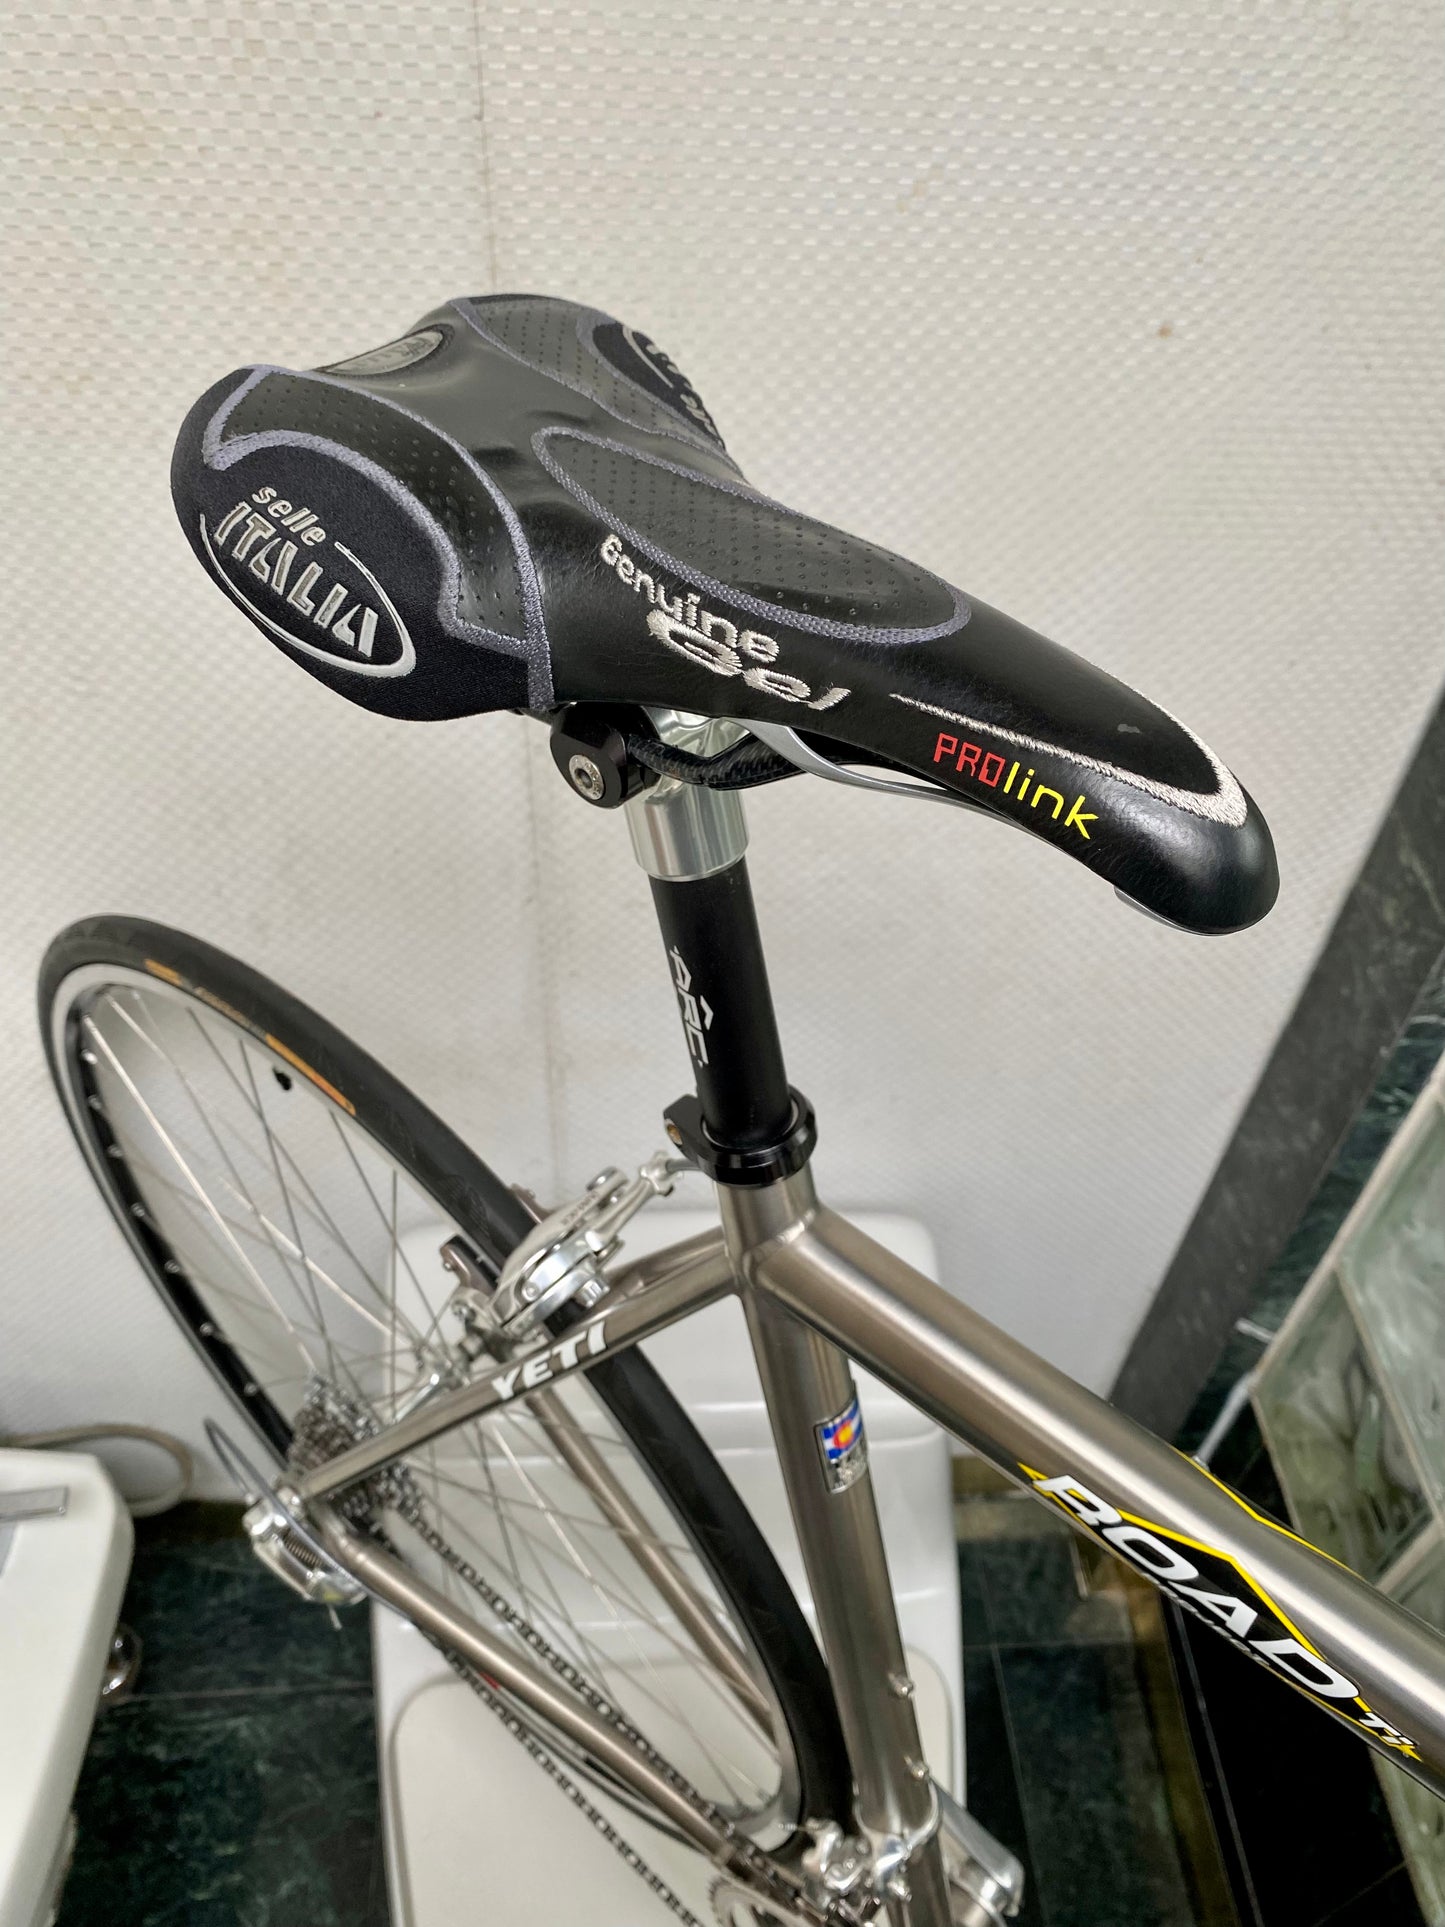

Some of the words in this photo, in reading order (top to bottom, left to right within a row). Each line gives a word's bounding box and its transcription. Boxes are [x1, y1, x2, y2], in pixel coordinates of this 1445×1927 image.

[251, 486, 327, 546] selle
[213, 501, 379, 658] ITALIA
[600, 534, 780, 663] Genuine
[646, 609, 851, 711] Gel
[491, 1320, 607, 1400] YETI
[1035, 1474, 1360, 1699] ROAD
